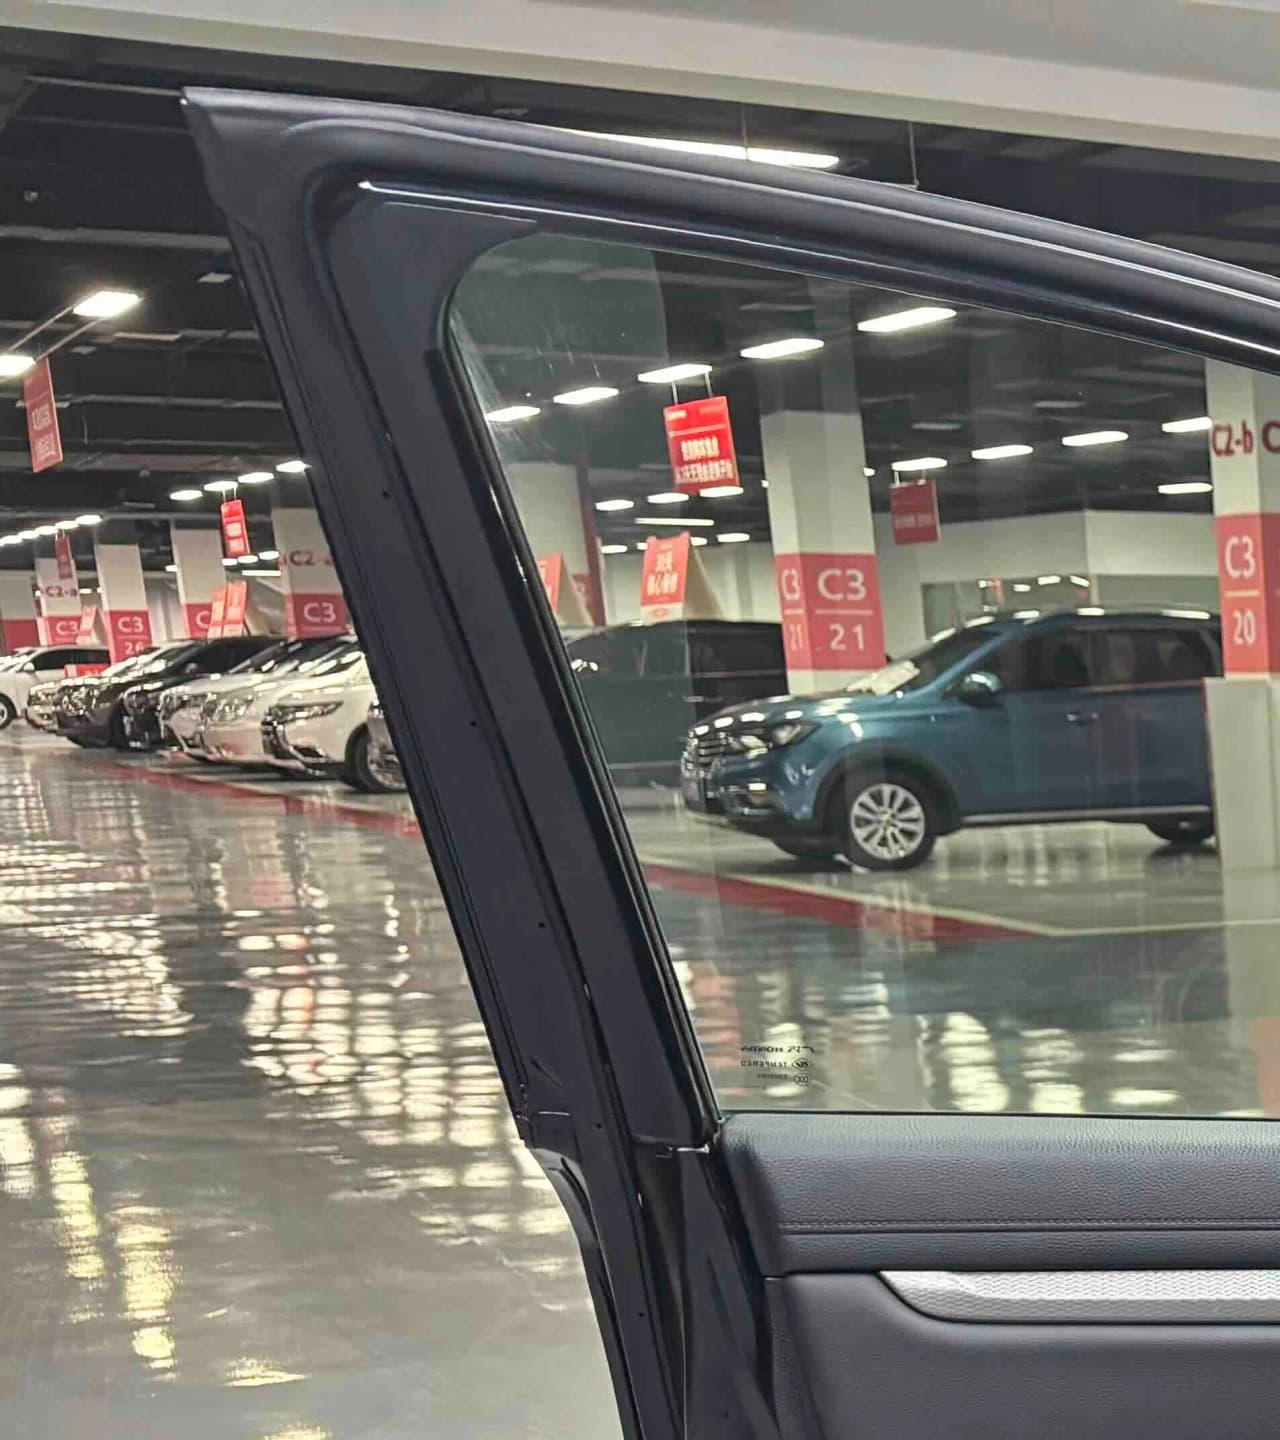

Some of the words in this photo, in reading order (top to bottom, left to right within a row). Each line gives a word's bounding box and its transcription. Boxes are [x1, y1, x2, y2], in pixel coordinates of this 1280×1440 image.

[1212, 420, 1254, 456] C2-b
[1224, 534, 1256, 579] C3
[781, 568, 801, 601] C3
[817, 568, 867, 601] C3
[55, 621, 78, 636] C3
[117, 616, 144, 633] C3
[303, 602, 336, 623] C3
[1232, 609, 1256, 645] 20
[829, 623, 865, 652] 21
